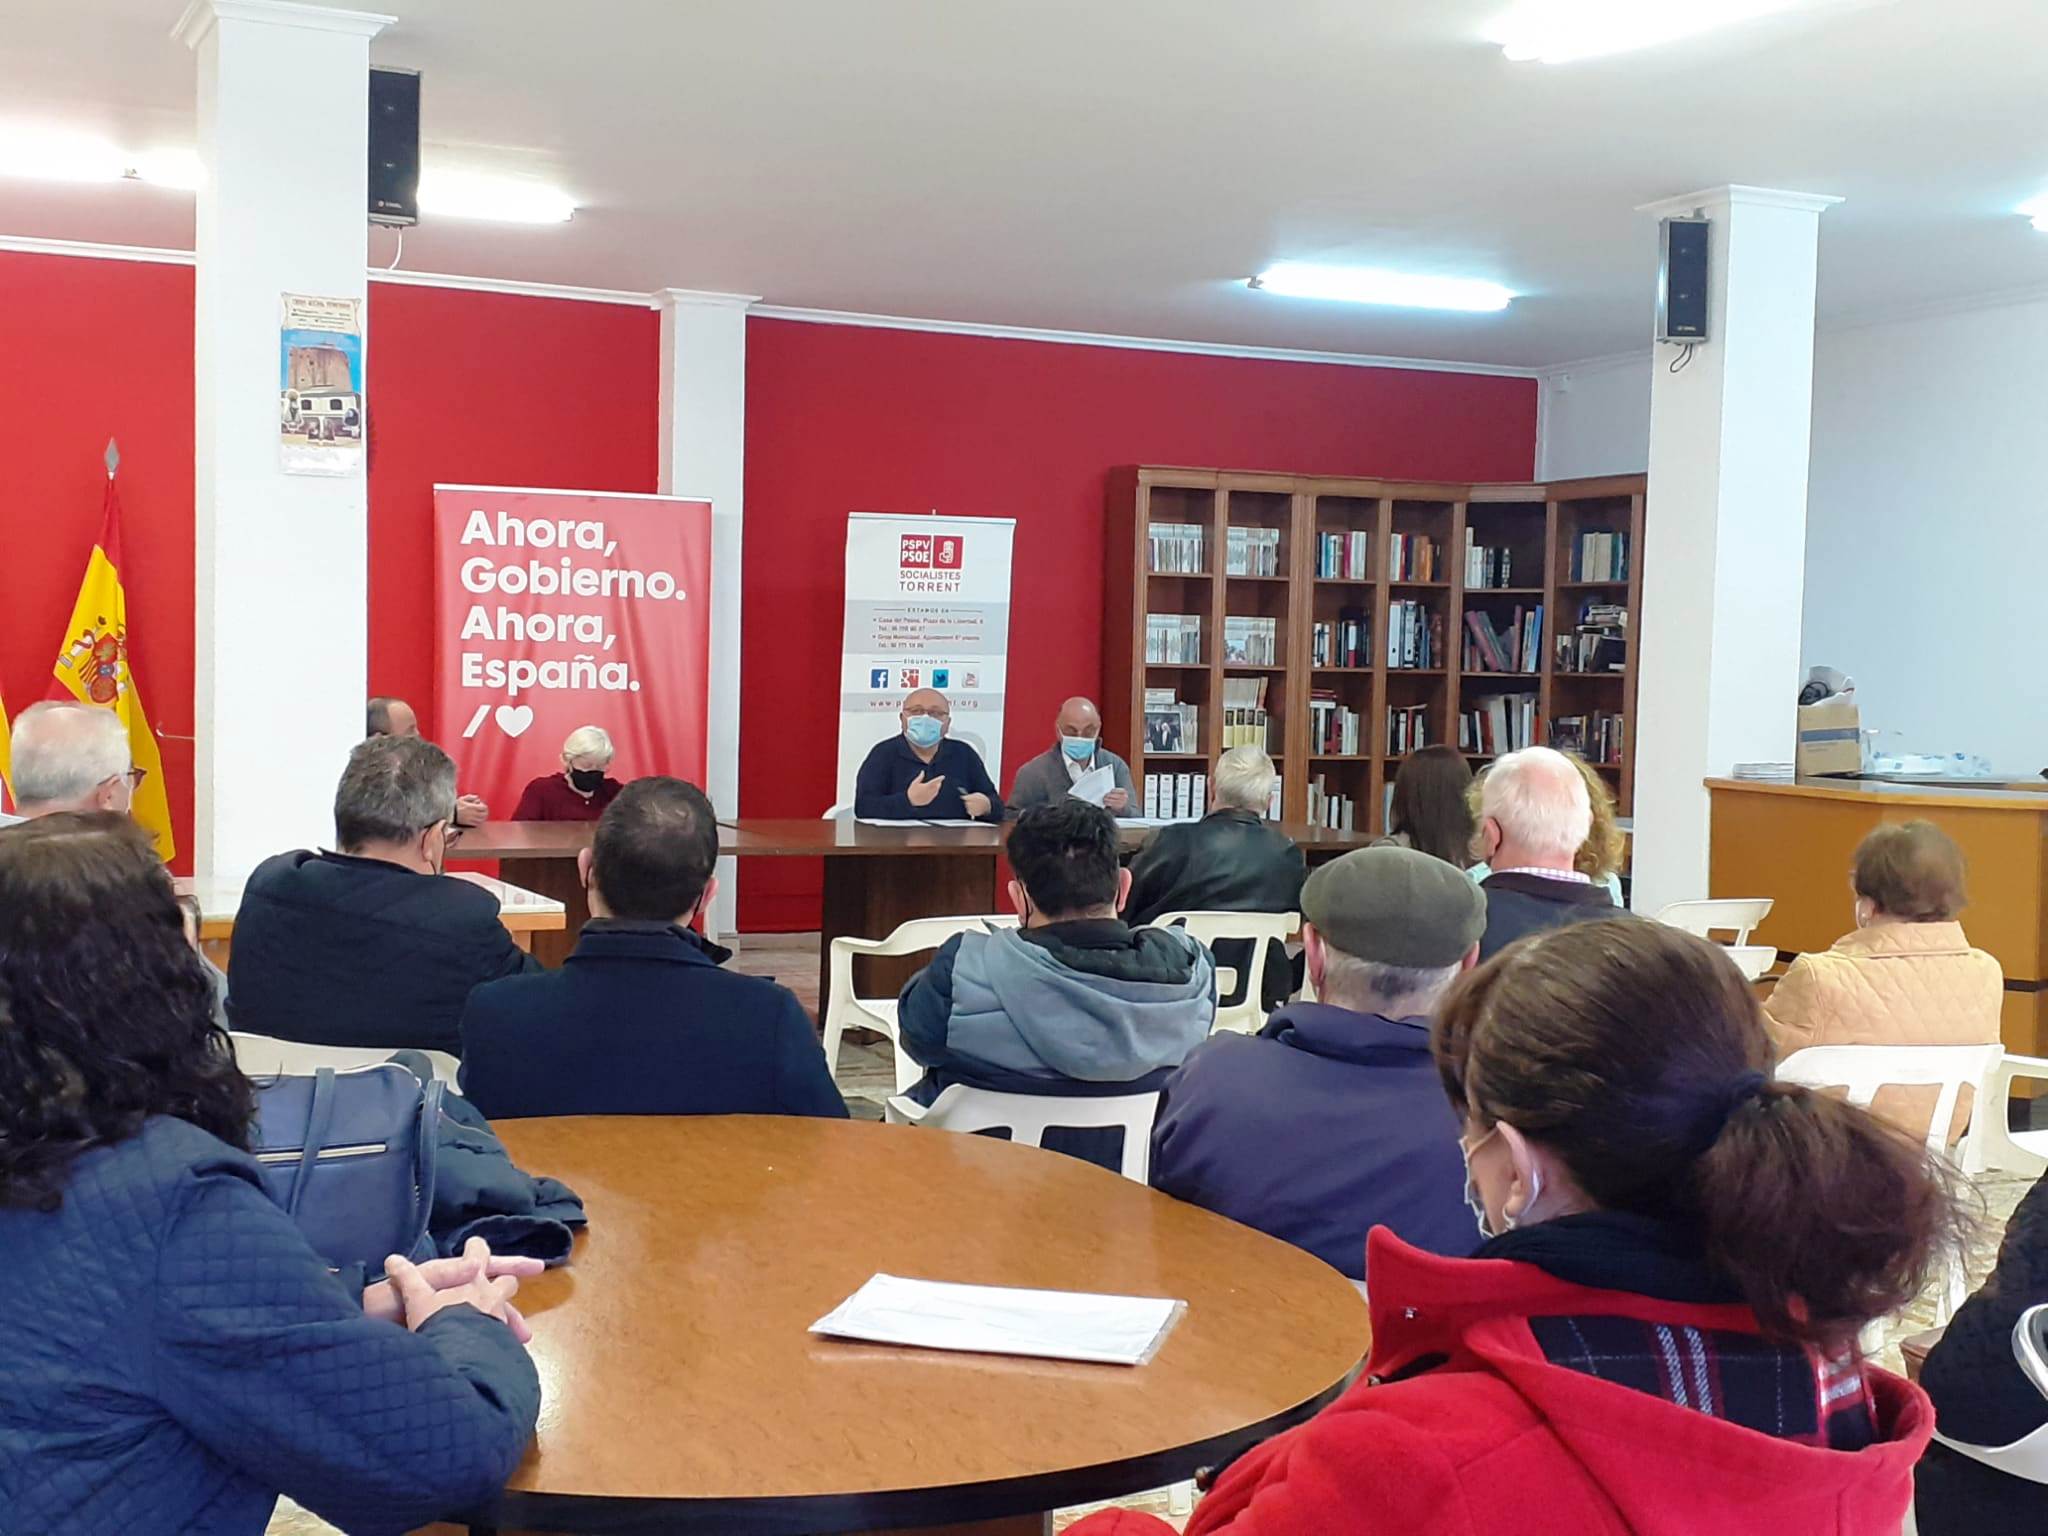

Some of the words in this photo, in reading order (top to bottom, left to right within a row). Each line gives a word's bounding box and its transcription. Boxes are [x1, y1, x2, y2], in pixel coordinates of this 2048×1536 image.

[460, 510, 618, 557] Ahora,
[902, 539, 930, 550] PSPV
[902, 551, 930, 563] PSOE
[460, 556, 686, 600] Gobierno.
[900, 570, 961, 581] SOCIALISTES
[900, 581, 961, 592] TORRENT
[460, 605, 616, 650] Ahora,
[461, 653, 641, 696] España.
